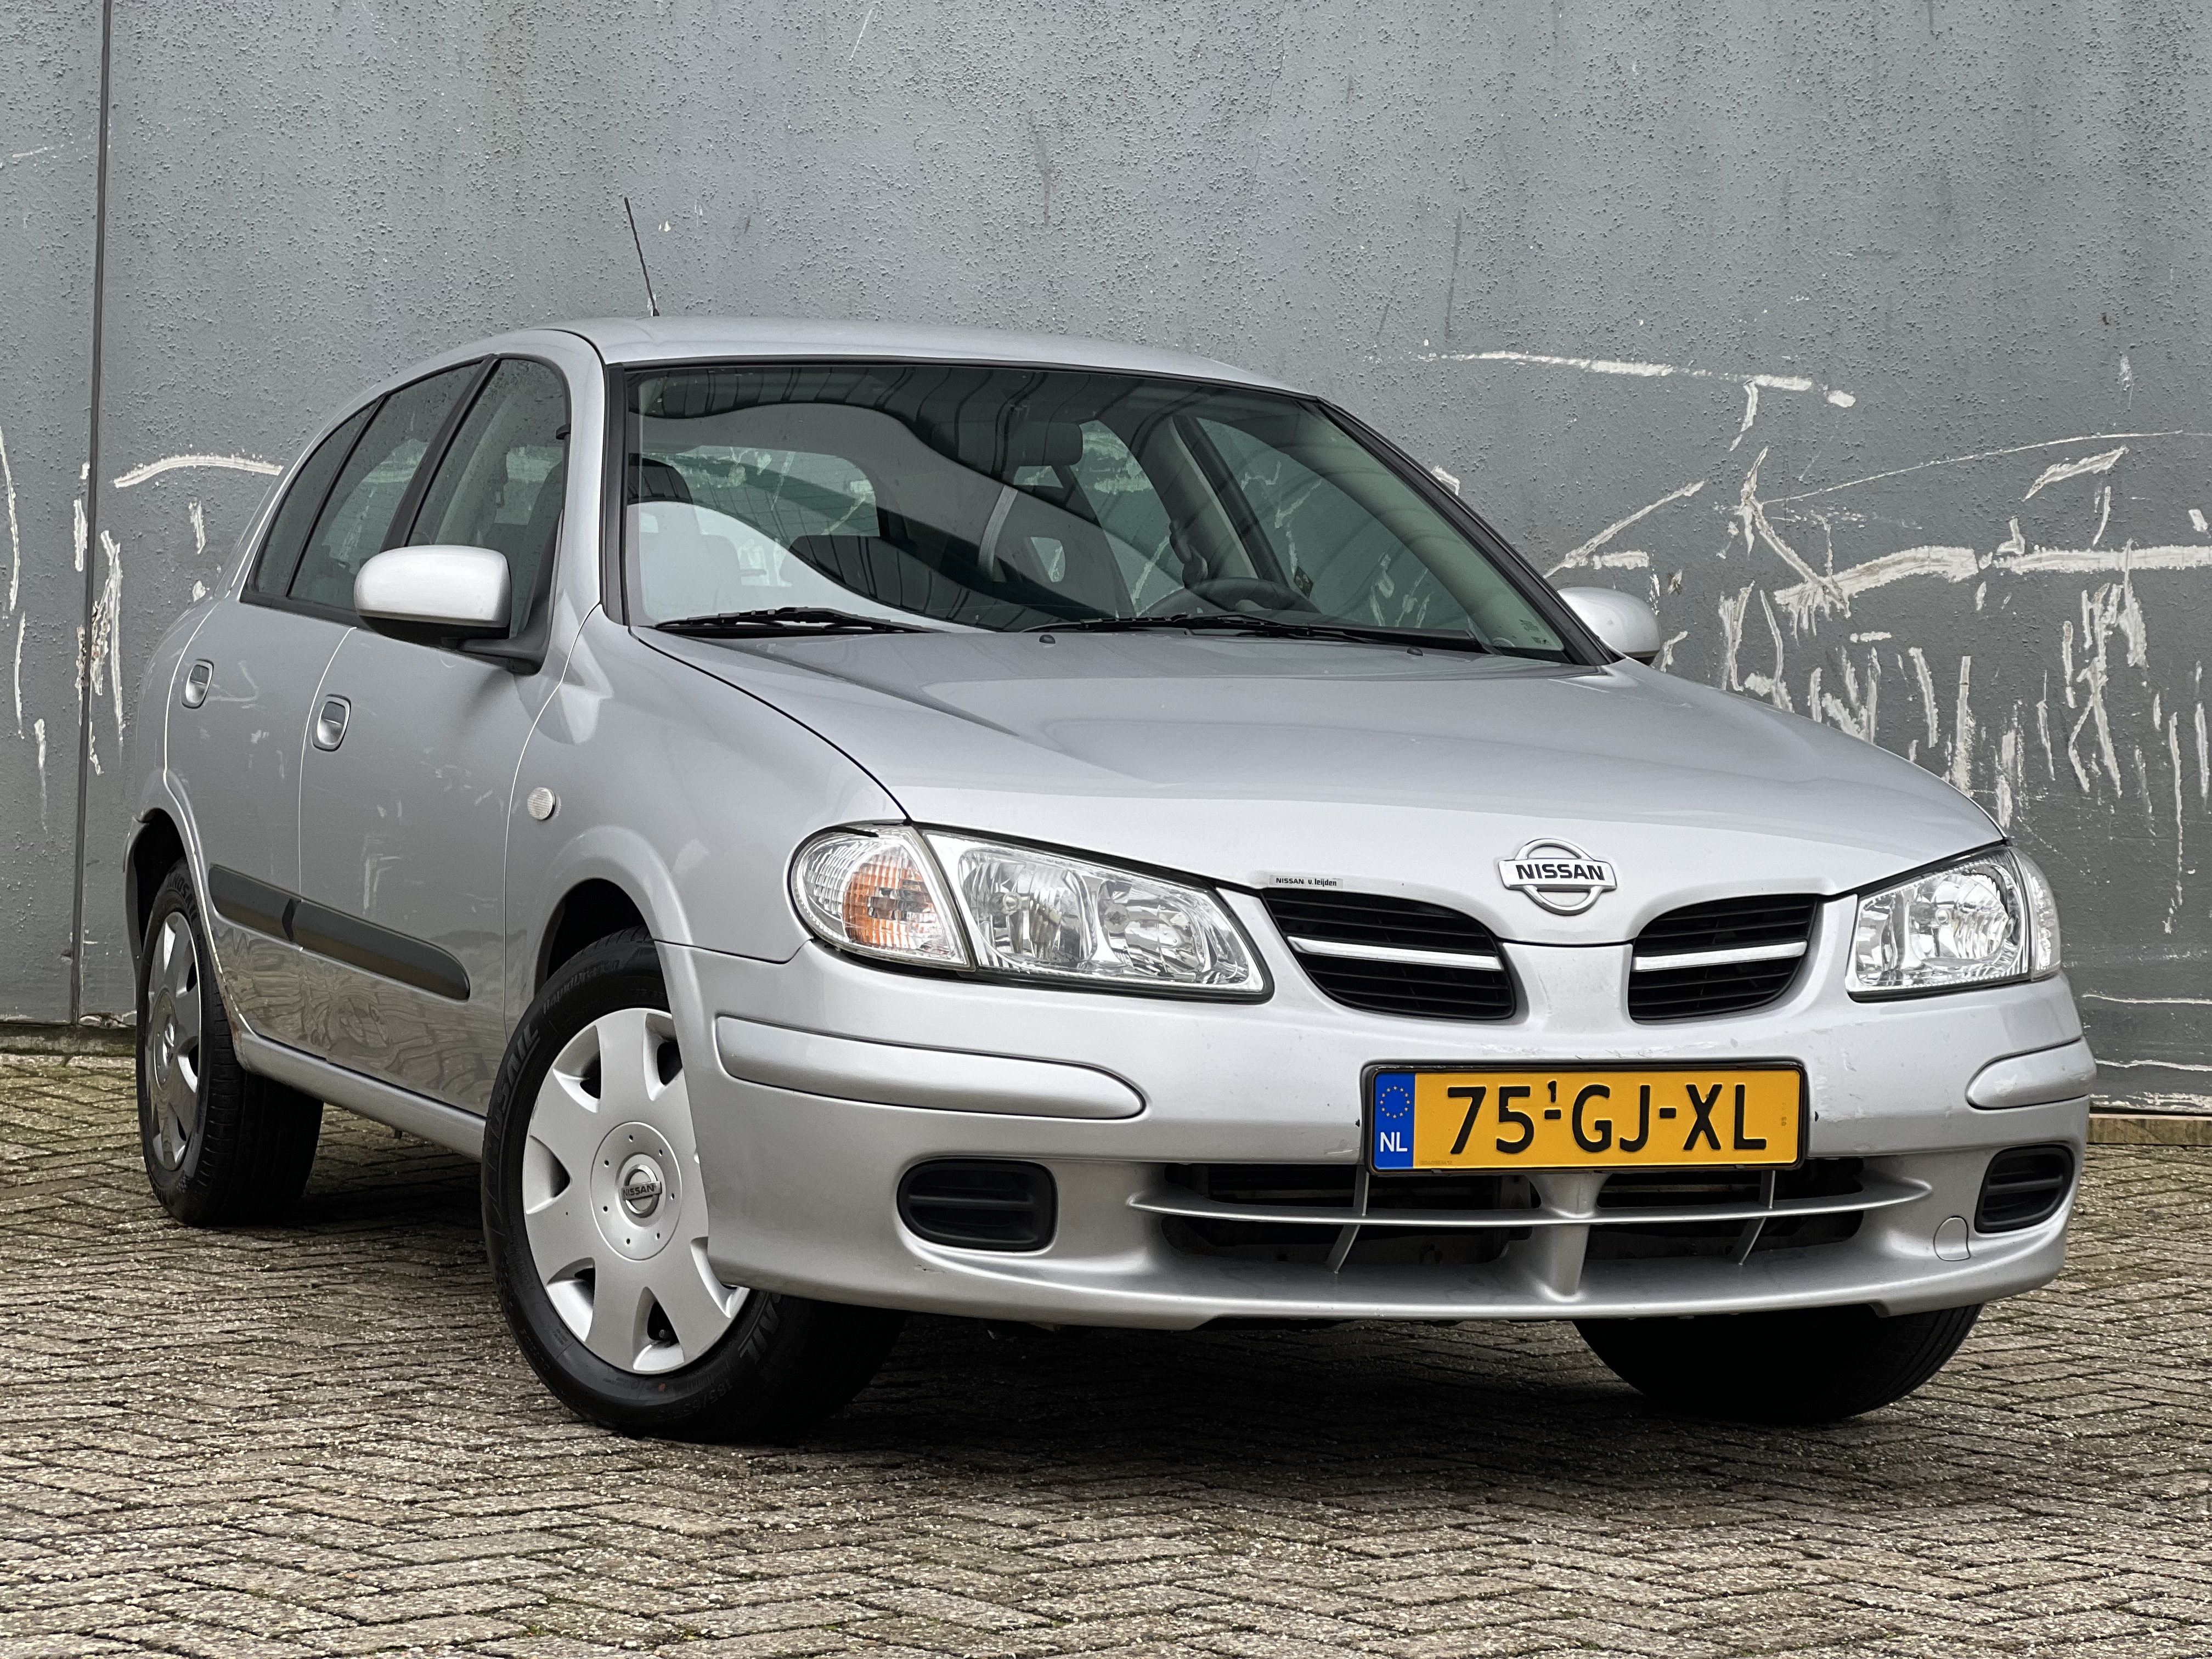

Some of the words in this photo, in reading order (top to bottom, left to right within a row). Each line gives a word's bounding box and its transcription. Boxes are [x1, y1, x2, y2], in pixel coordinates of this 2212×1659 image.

[1516, 864, 1605, 881] NISSAN
[1380, 1132, 1408, 1152] NL
[623, 1183, 655, 1197] NISSAN
